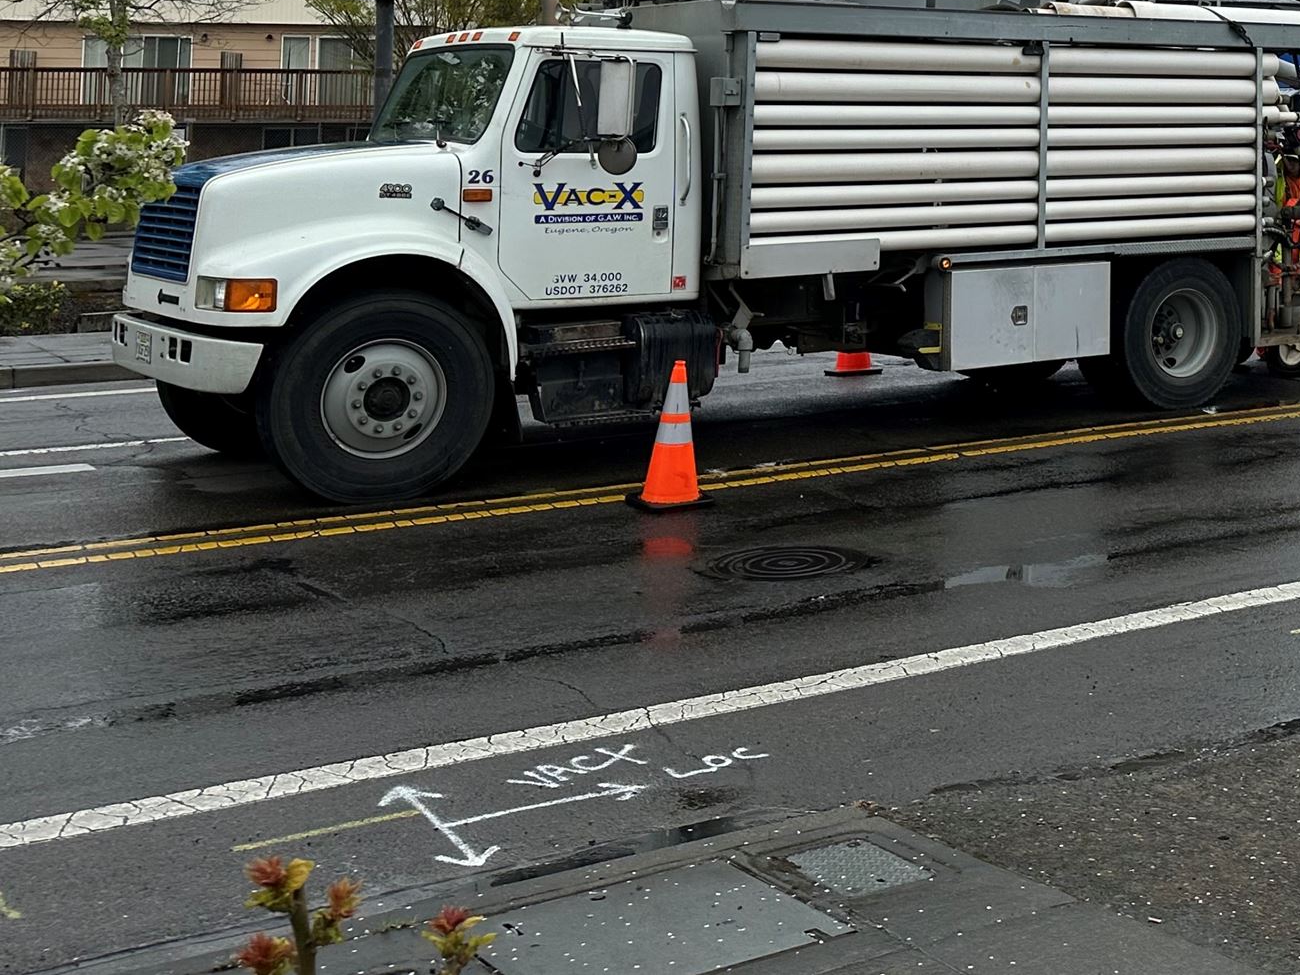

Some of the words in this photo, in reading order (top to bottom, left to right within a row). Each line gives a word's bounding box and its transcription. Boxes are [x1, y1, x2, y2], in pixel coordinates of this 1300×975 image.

[468, 169, 494, 184] 26
[598, 214, 622, 222] G.A.W.
[544, 227, 590, 235] Eugene,
[591, 225, 635, 234] Oregon
[583, 272, 622, 283] 34,000
[545, 285, 583, 296] USDOT
[589, 283, 628, 294] 376262
